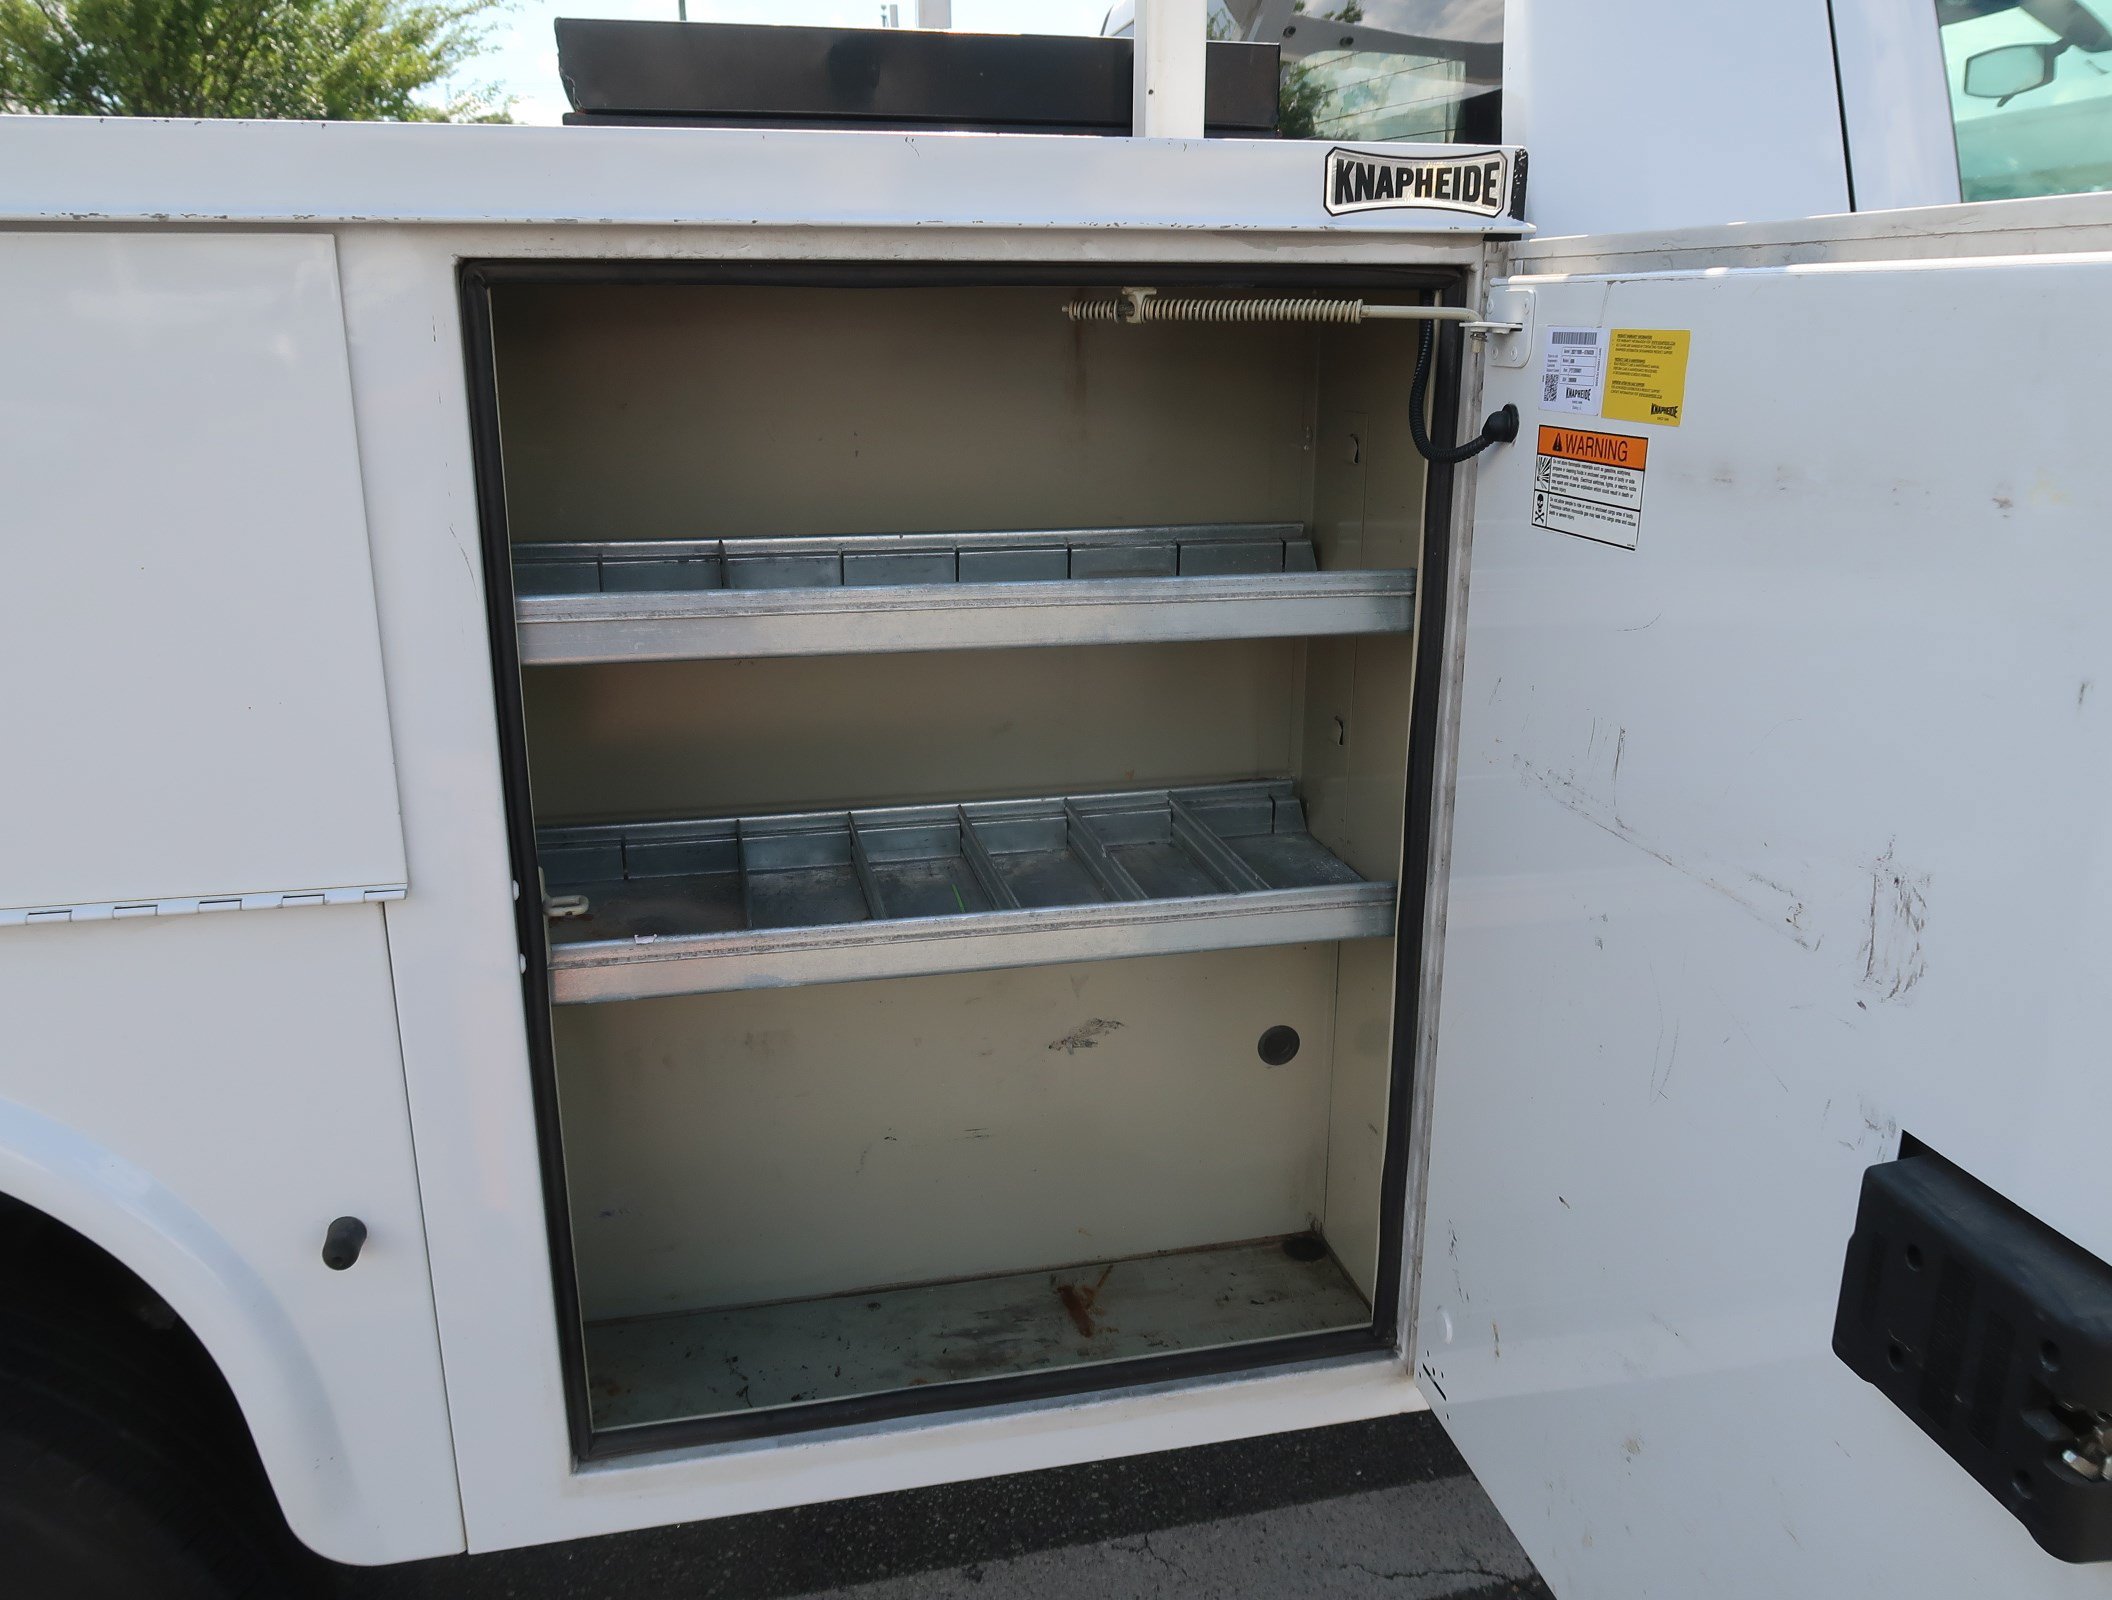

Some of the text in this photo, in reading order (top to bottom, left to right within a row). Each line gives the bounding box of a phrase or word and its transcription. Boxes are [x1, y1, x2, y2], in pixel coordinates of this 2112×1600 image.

[1334, 159, 1500, 208] KNAPHEIDE
[1566, 387, 1592, 401] KNAPHEIDE
[1651, 403, 1679, 418] KNAPHEIDE
[1565, 434, 1628, 462] WARNING
